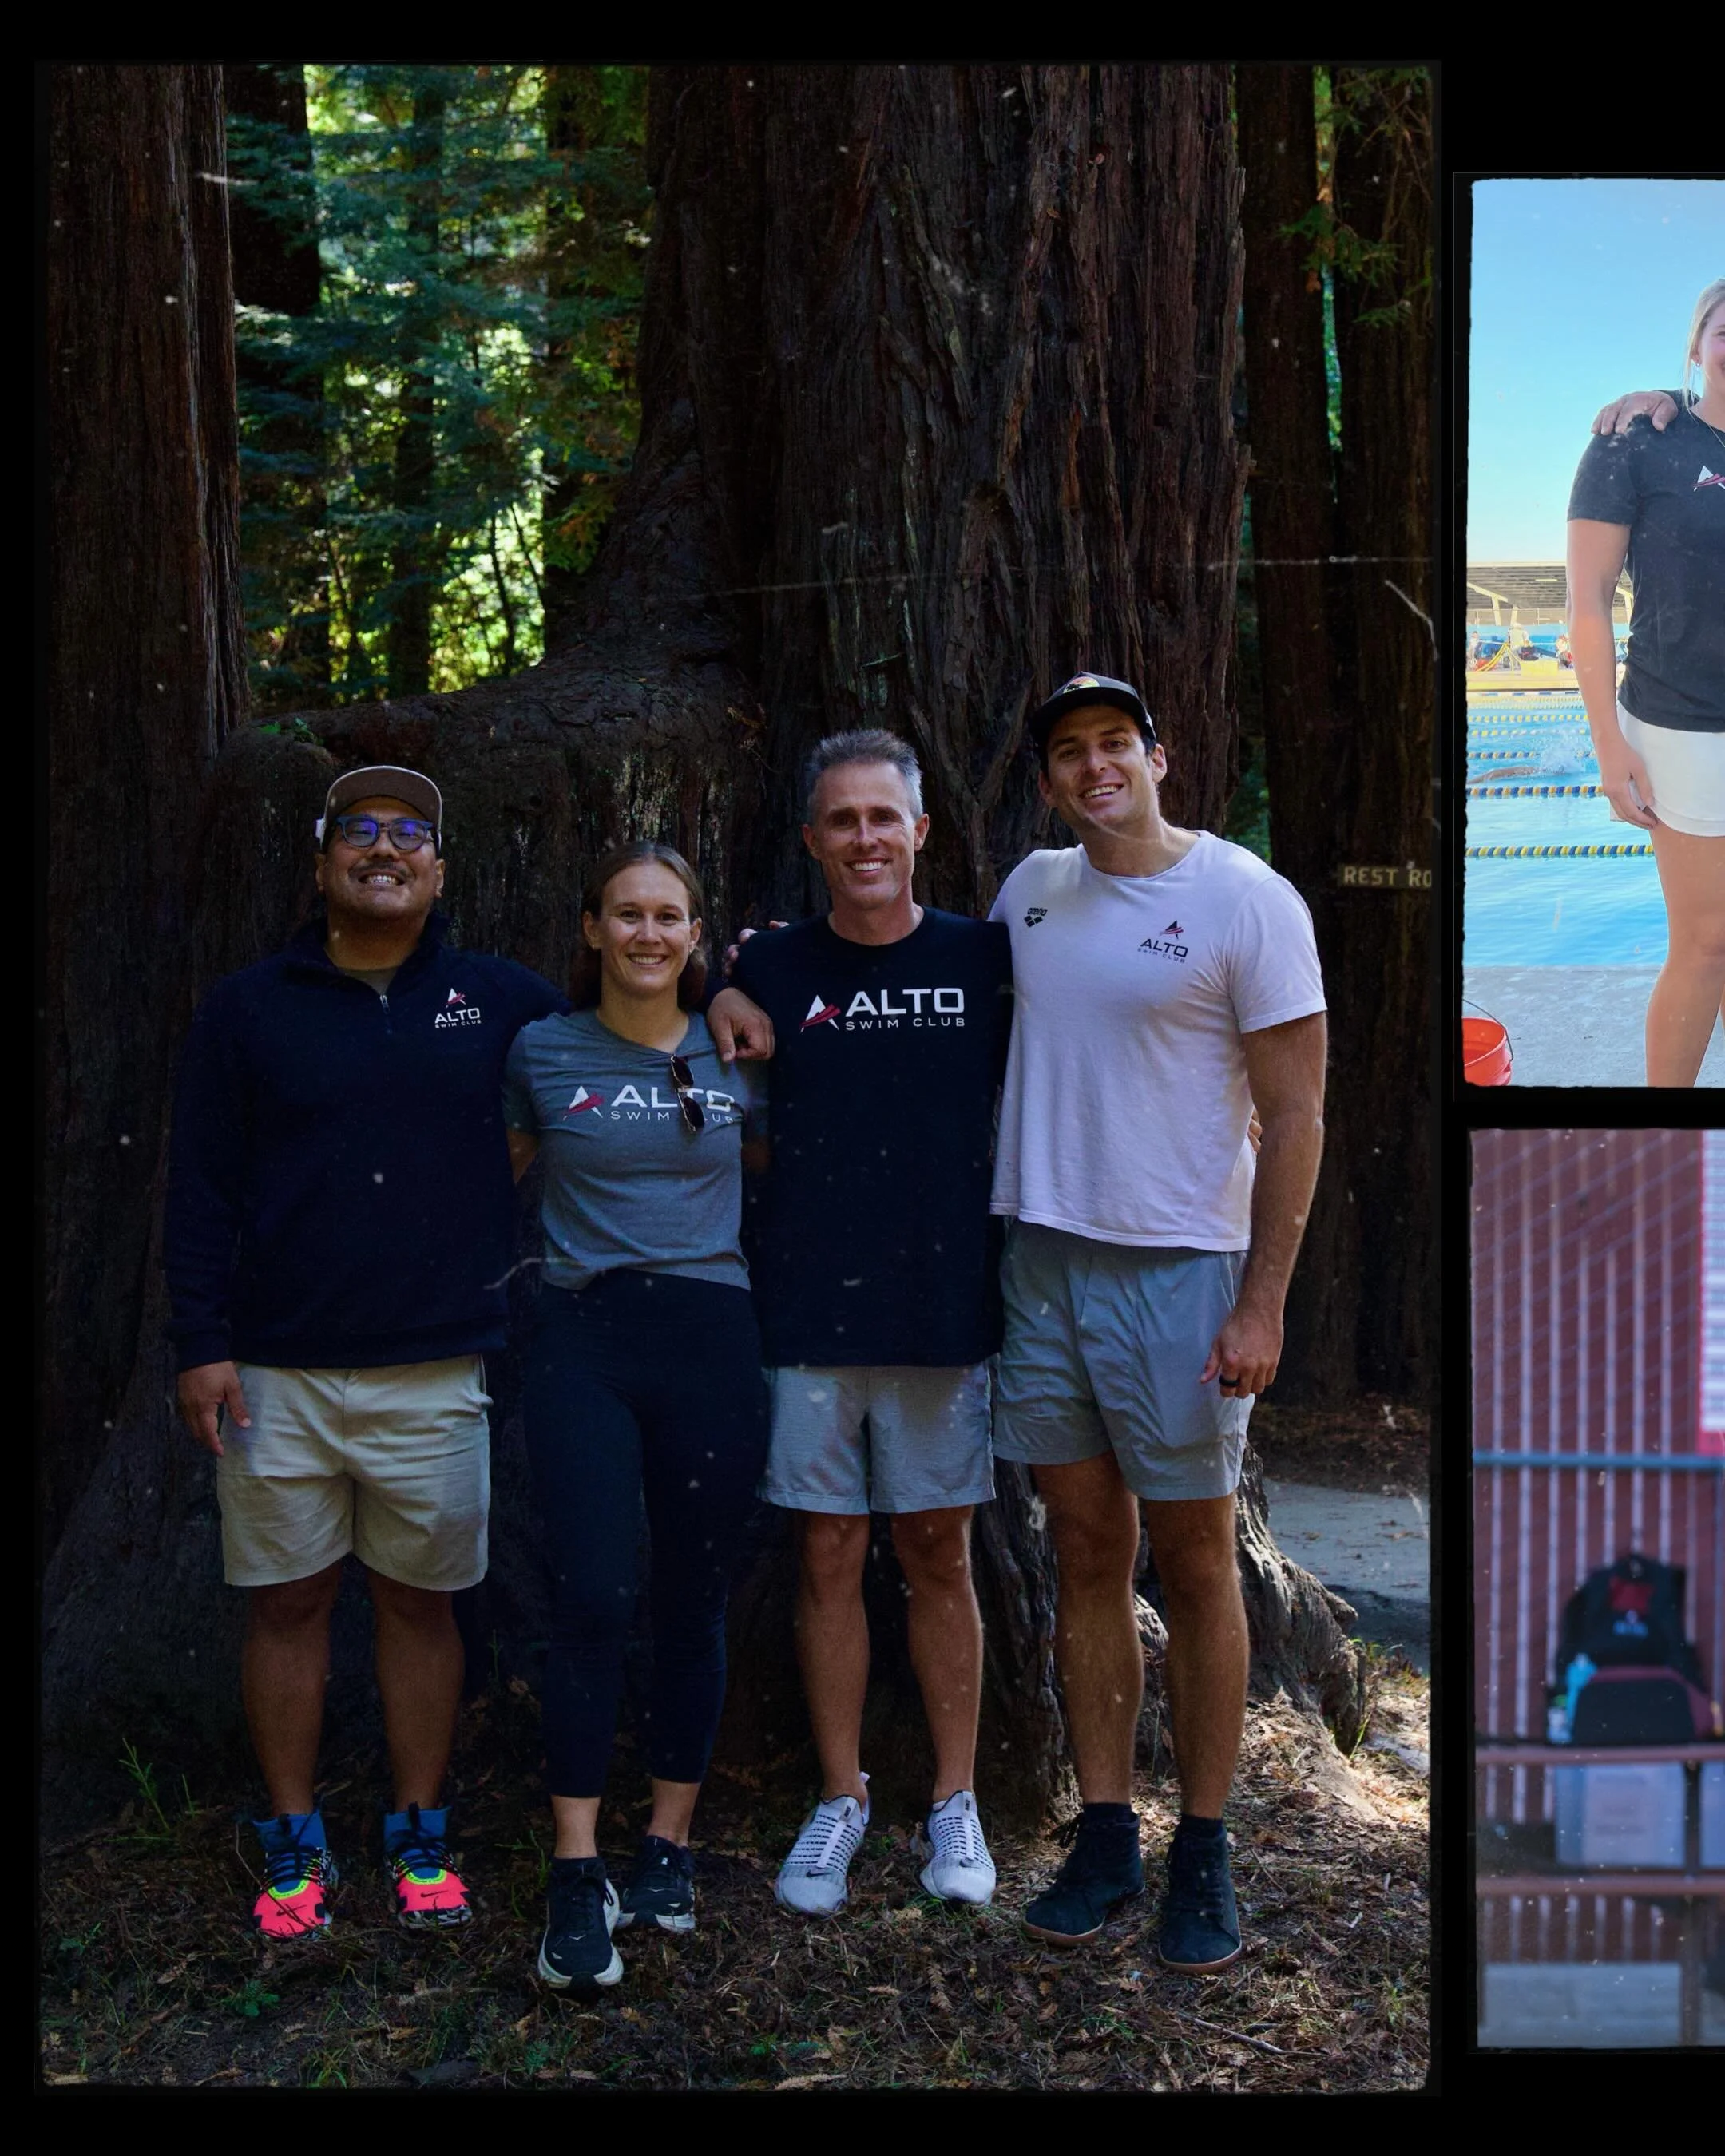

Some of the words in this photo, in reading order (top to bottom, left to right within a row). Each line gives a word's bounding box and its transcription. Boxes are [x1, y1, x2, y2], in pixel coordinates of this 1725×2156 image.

[1344, 866, 1398, 886] REST
[1027, 907, 1048, 916] arena
[1140, 938, 1188, 957] ALTO
[846, 988, 965, 1017] ALTO
[434, 1008, 481, 1024] ALTO
[846, 1019, 899, 1031] SWIM
[913, 1017, 966, 1028] CLUB
[610, 1111, 670, 1121] SWIM
